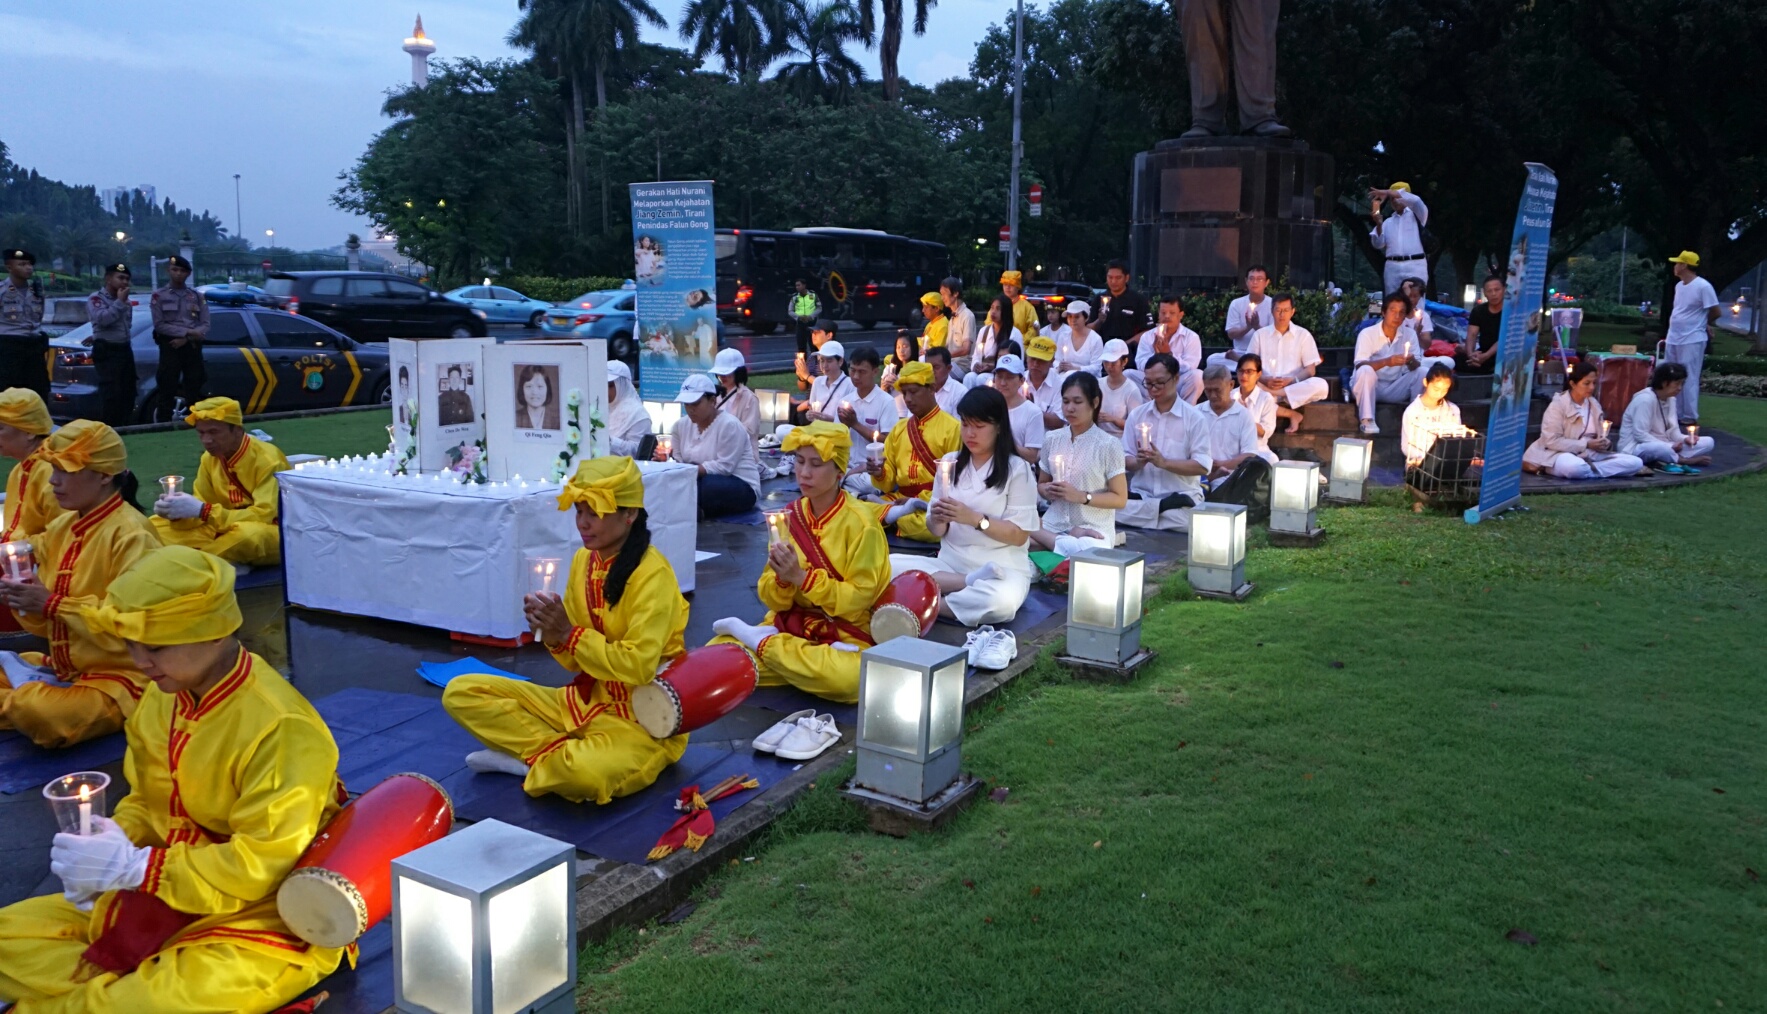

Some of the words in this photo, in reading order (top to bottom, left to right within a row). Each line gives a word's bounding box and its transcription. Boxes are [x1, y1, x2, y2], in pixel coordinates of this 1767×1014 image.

[636, 189, 666, 197] Gerakan
[666, 188, 681, 196] Hati
[681, 187, 706, 195] Nurani
[633, 199, 673, 209] Melaporkan
[674, 198, 711, 208] Kejahatan
[636, 209, 656, 220] Jiang
[685, 209, 705, 217] Tirani
[637, 221, 669, 230] Penindas
[669, 220, 689, 229] Falun
[690, 220, 709, 230] Gong
[294, 355, 336, 370] POLISI
